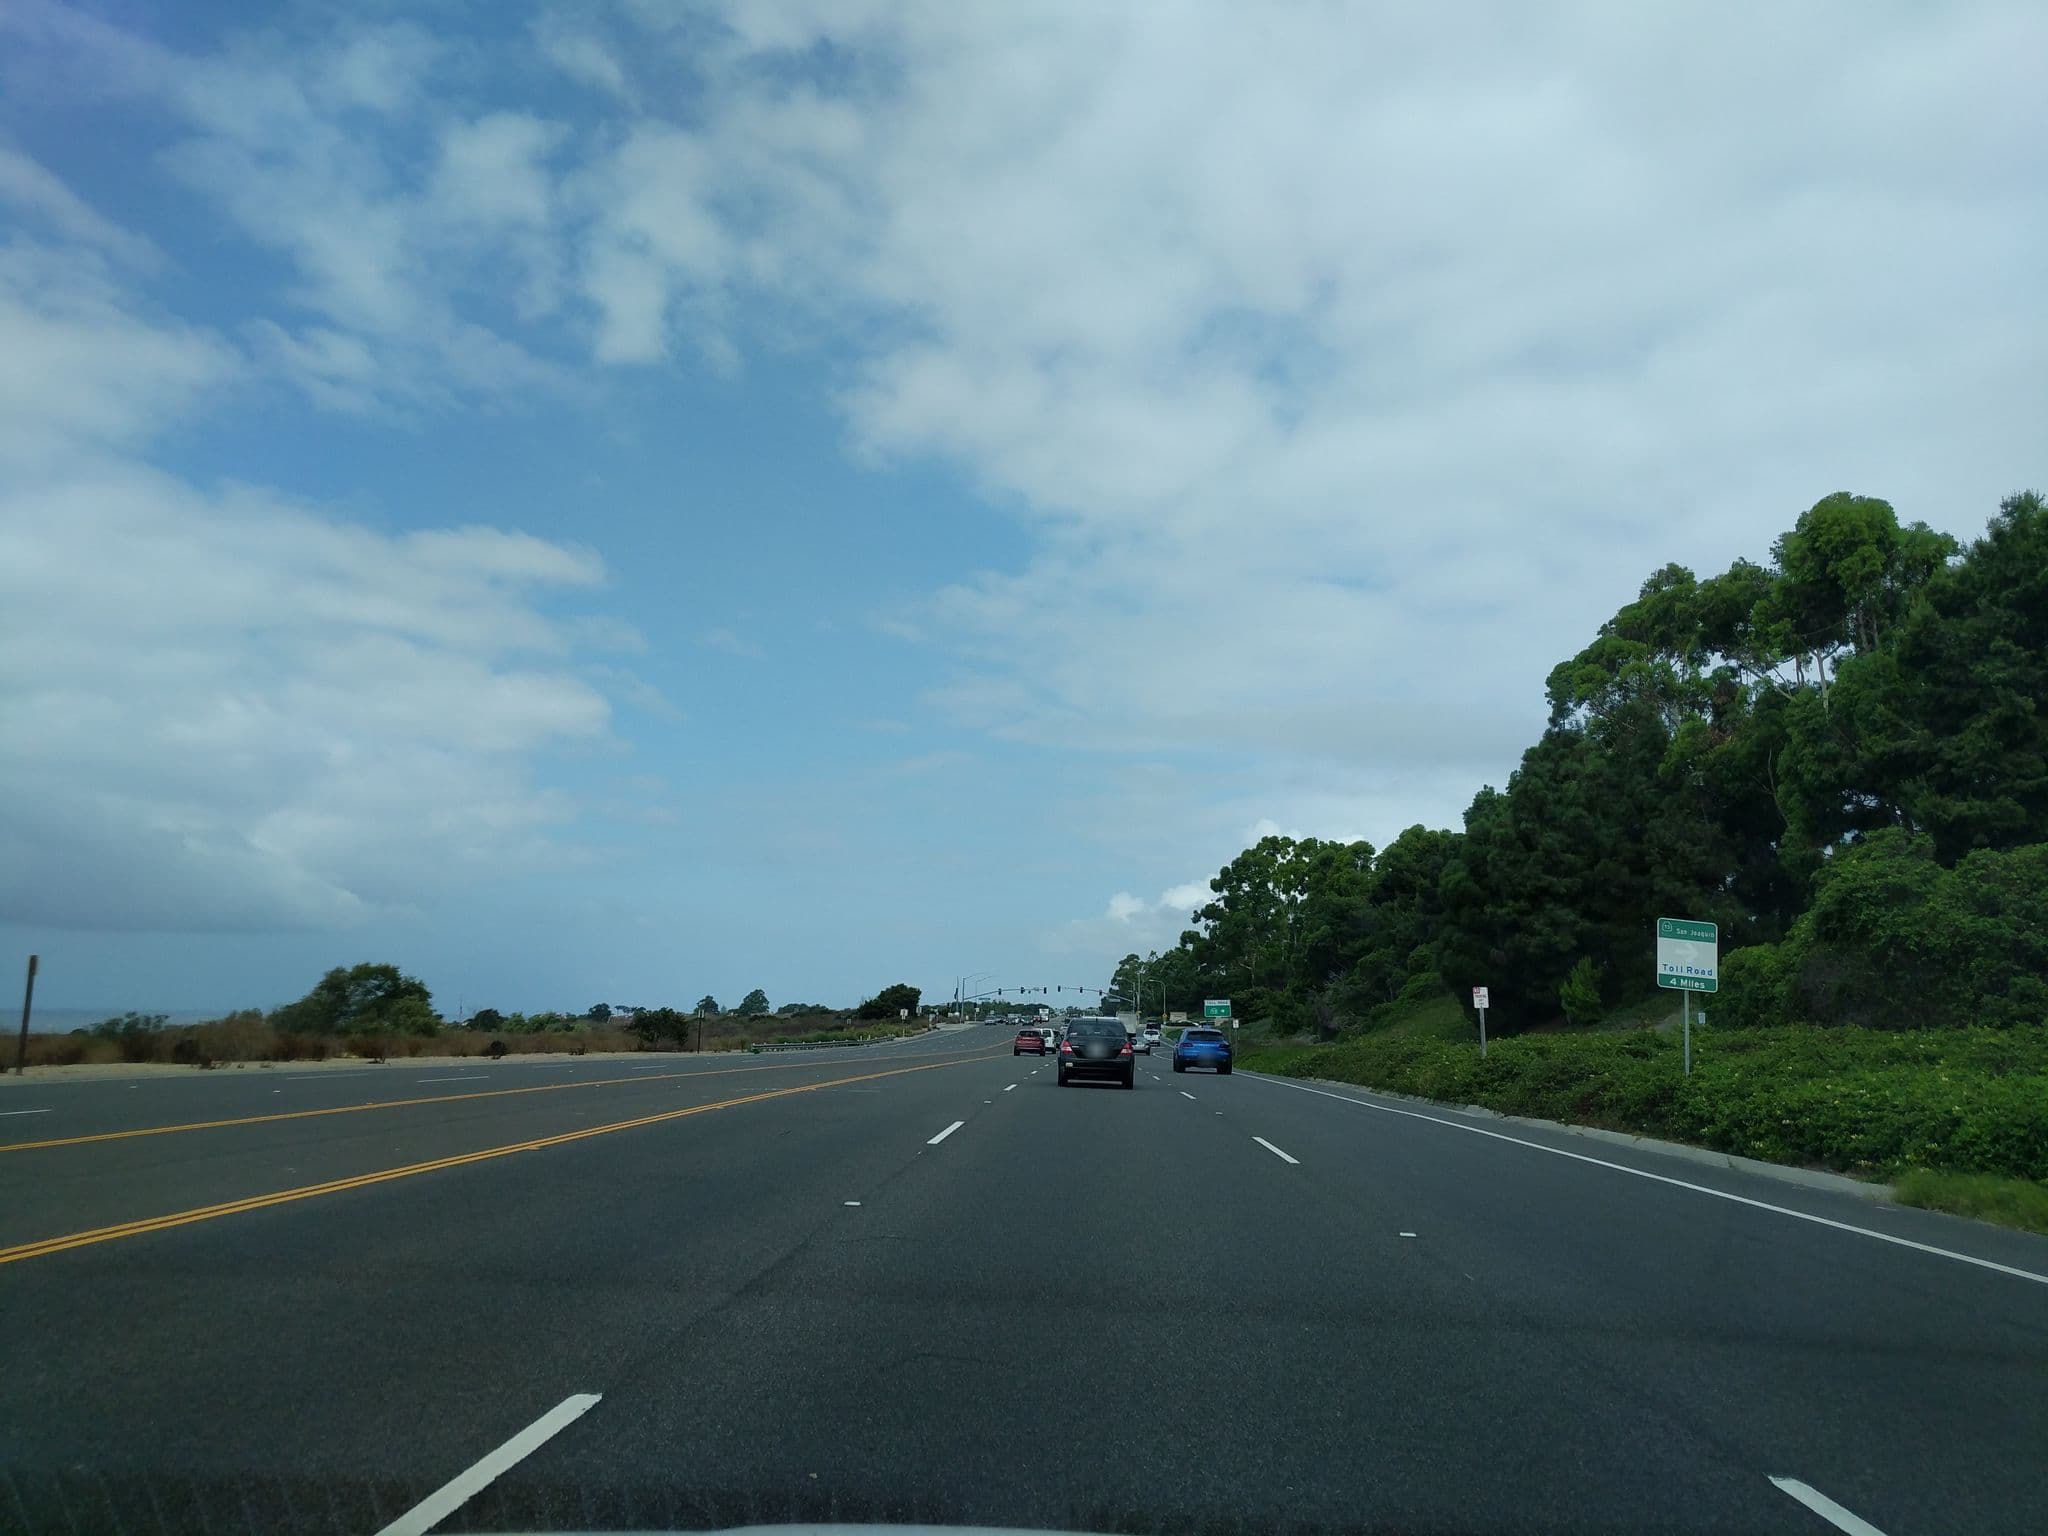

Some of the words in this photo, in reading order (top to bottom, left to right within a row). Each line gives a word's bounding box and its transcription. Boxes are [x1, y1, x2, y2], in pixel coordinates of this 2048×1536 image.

[1690, 929, 1715, 938] Joaquin
[1662, 963, 1683, 973] Toll
[1686, 966, 1713, 977] Road
[1670, 977, 1677, 986] 4
[1680, 978, 1706, 989] Miles
